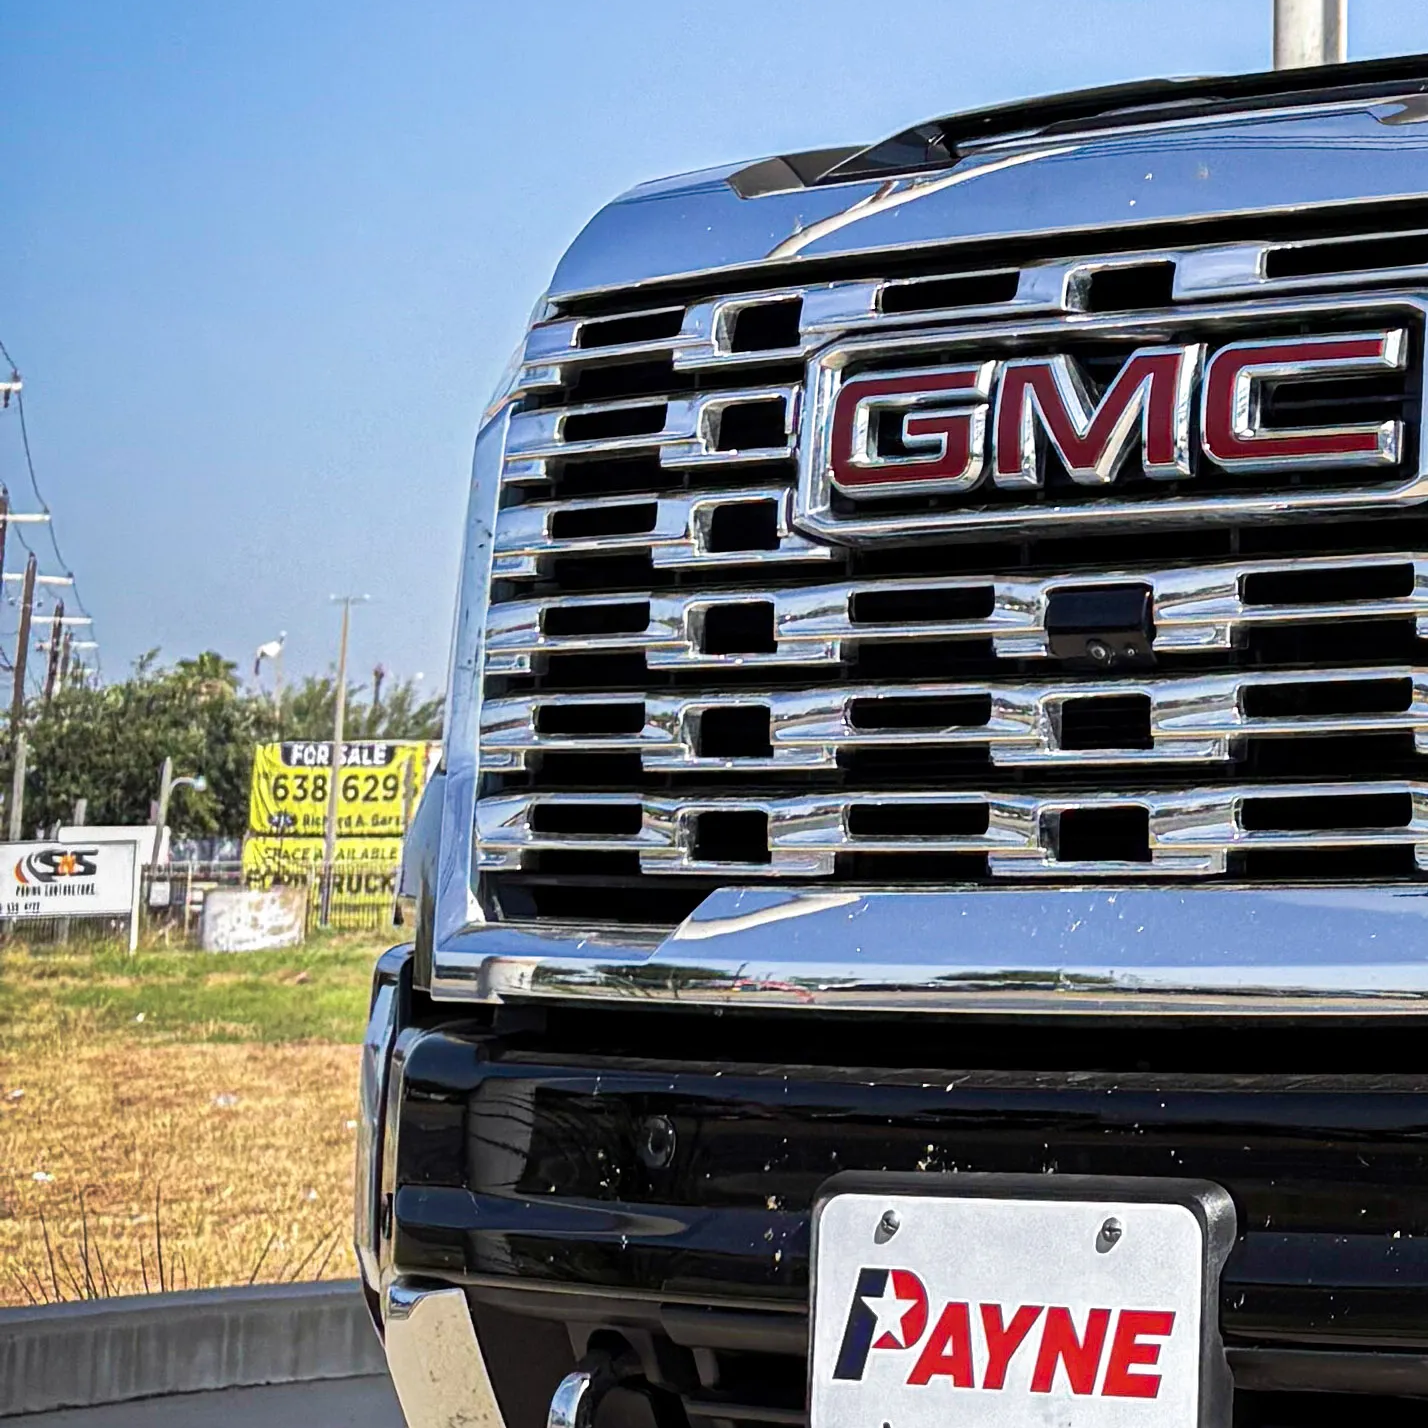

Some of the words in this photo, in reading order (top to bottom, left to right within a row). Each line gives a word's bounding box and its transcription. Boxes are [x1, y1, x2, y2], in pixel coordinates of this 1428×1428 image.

[829, 327, 1408, 498] GMC
[272, 774, 328, 802] 638
[290, 743, 329, 765] FOR
[339, 743, 388, 765] SALE
[832, 1268, 1177, 1400] PAYNE
